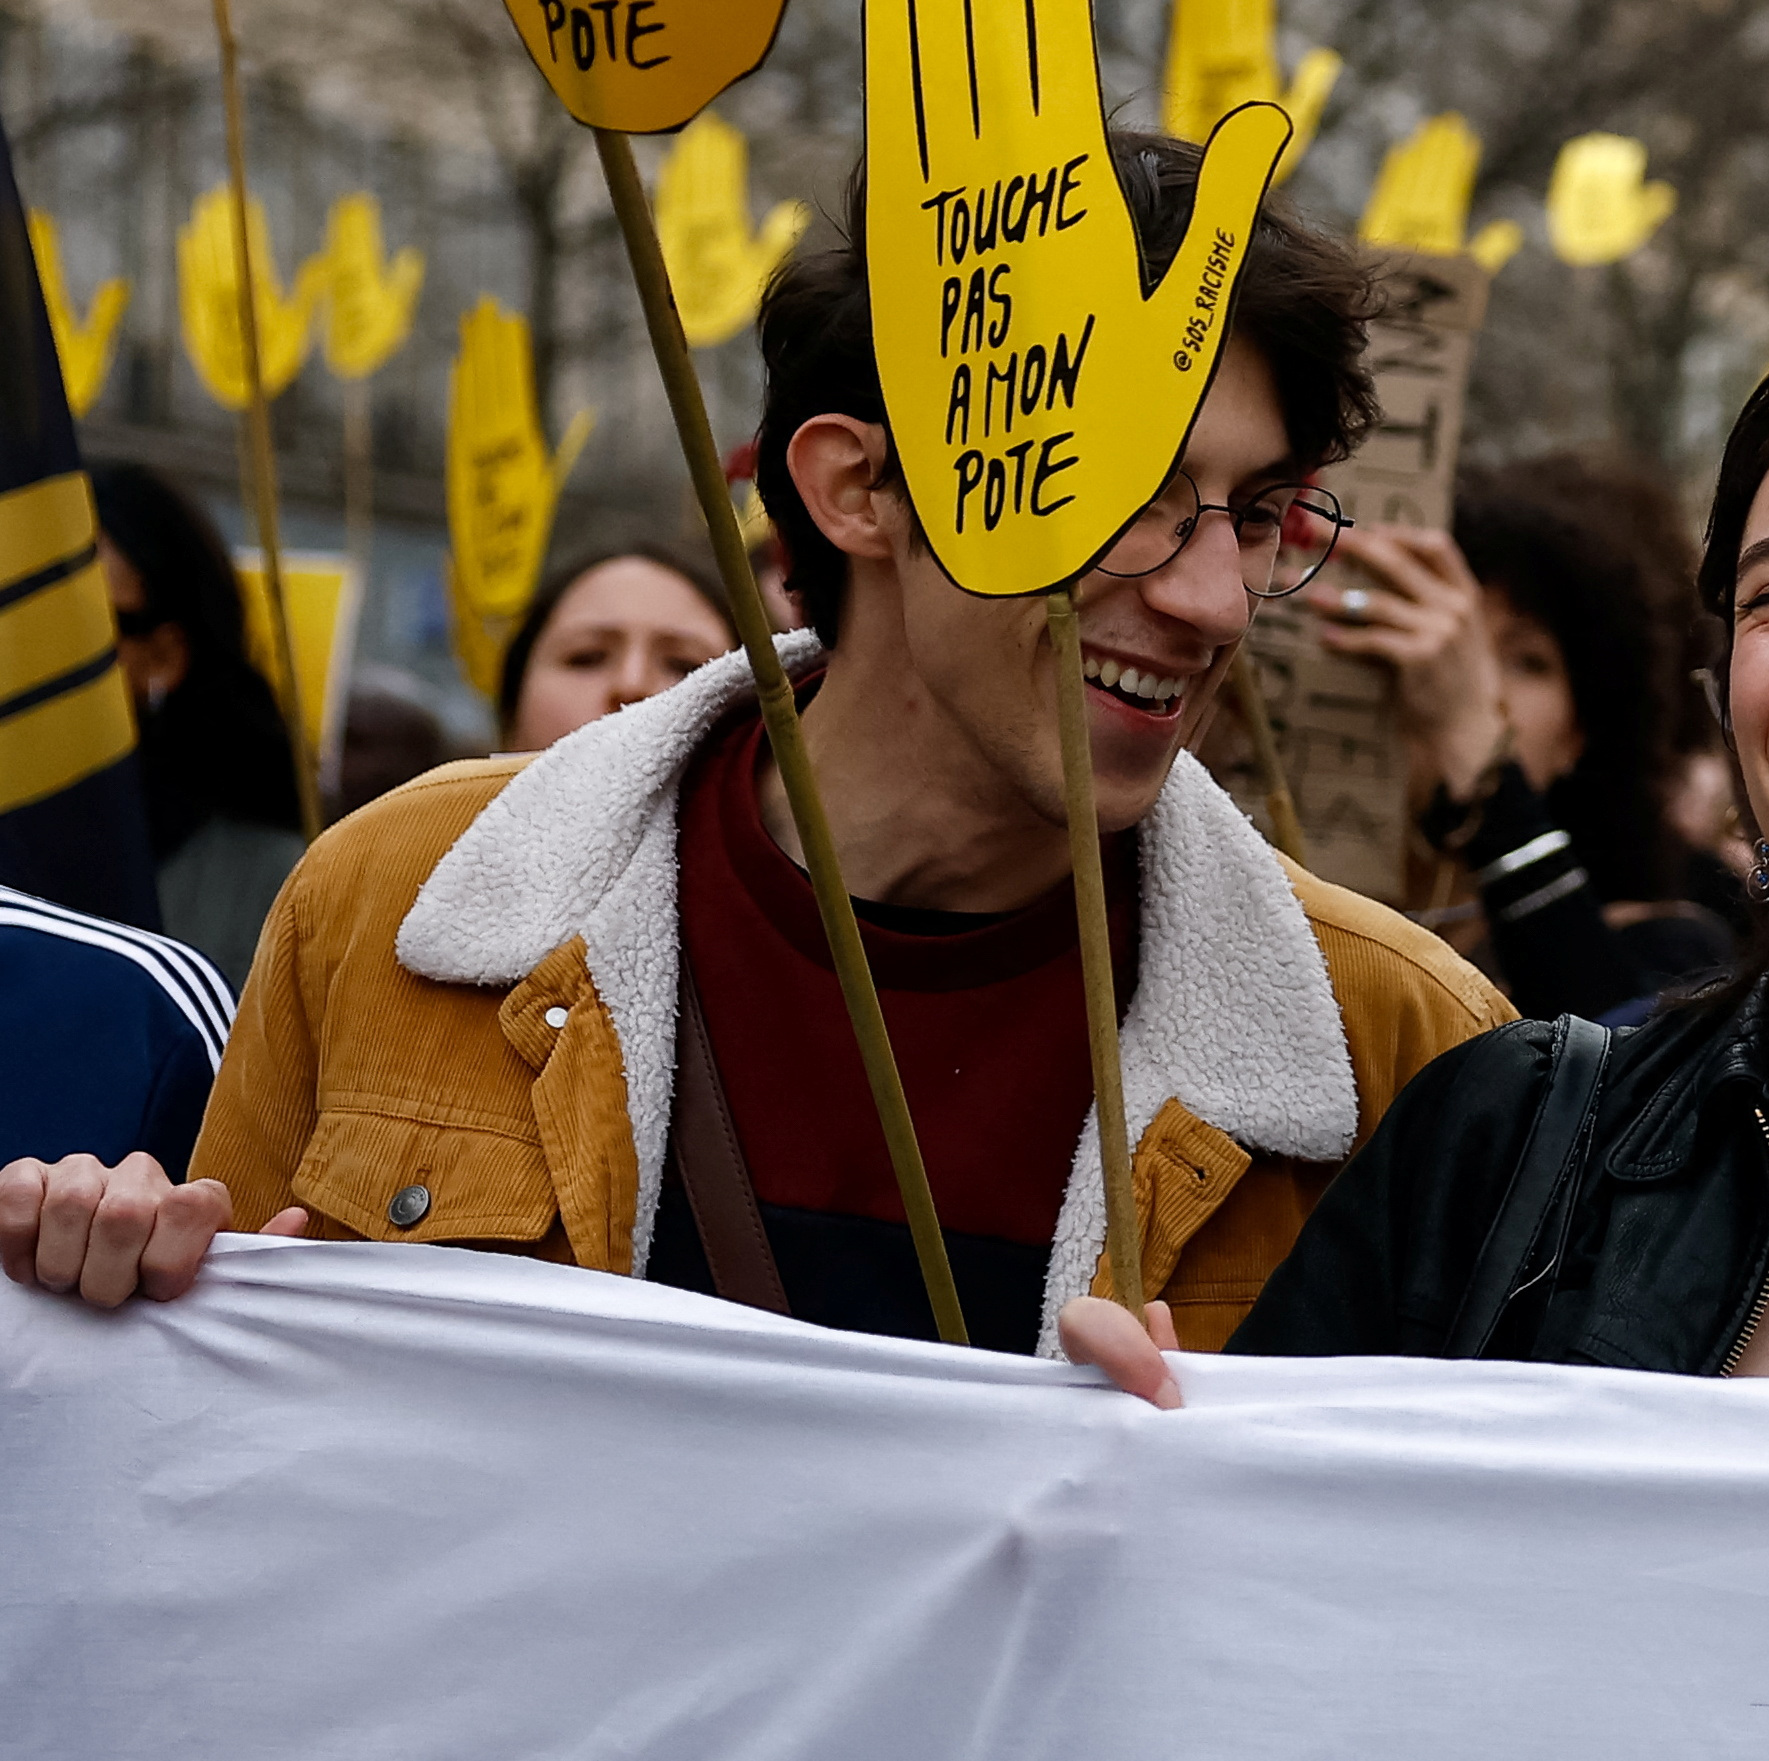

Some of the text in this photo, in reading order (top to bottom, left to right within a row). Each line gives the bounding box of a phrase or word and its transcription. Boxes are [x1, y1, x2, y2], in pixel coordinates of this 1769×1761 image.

[920, 153, 1089, 266] TOUCHE
[940, 263, 1012, 358] PAS
[1173, 226, 1235, 372] @SOS_RACISME
[946, 313, 1096, 445] A MON
[953, 431, 1080, 535] POTE
